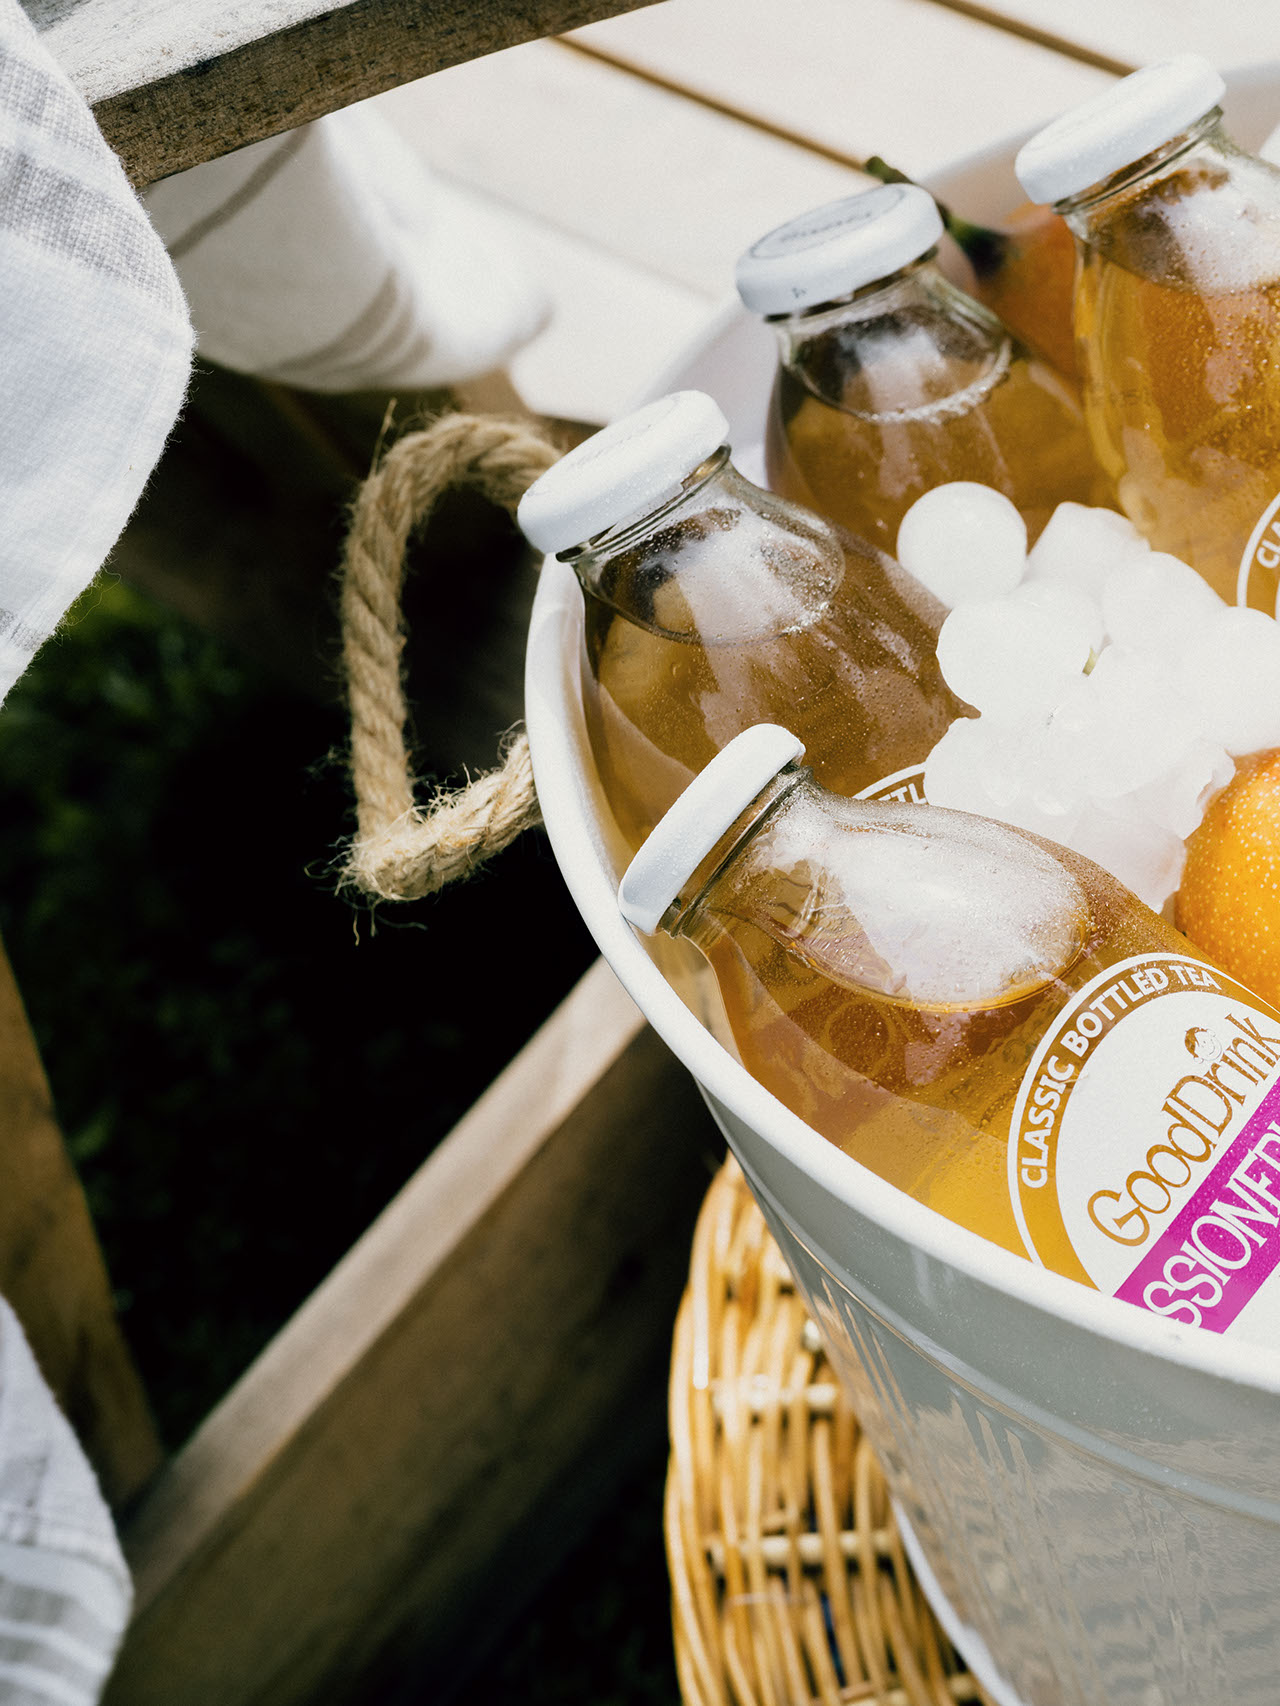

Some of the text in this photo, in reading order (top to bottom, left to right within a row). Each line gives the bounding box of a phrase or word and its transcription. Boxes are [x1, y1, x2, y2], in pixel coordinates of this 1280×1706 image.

[1021, 965, 1222, 1188] CLASSIC BOTTLED TEA
